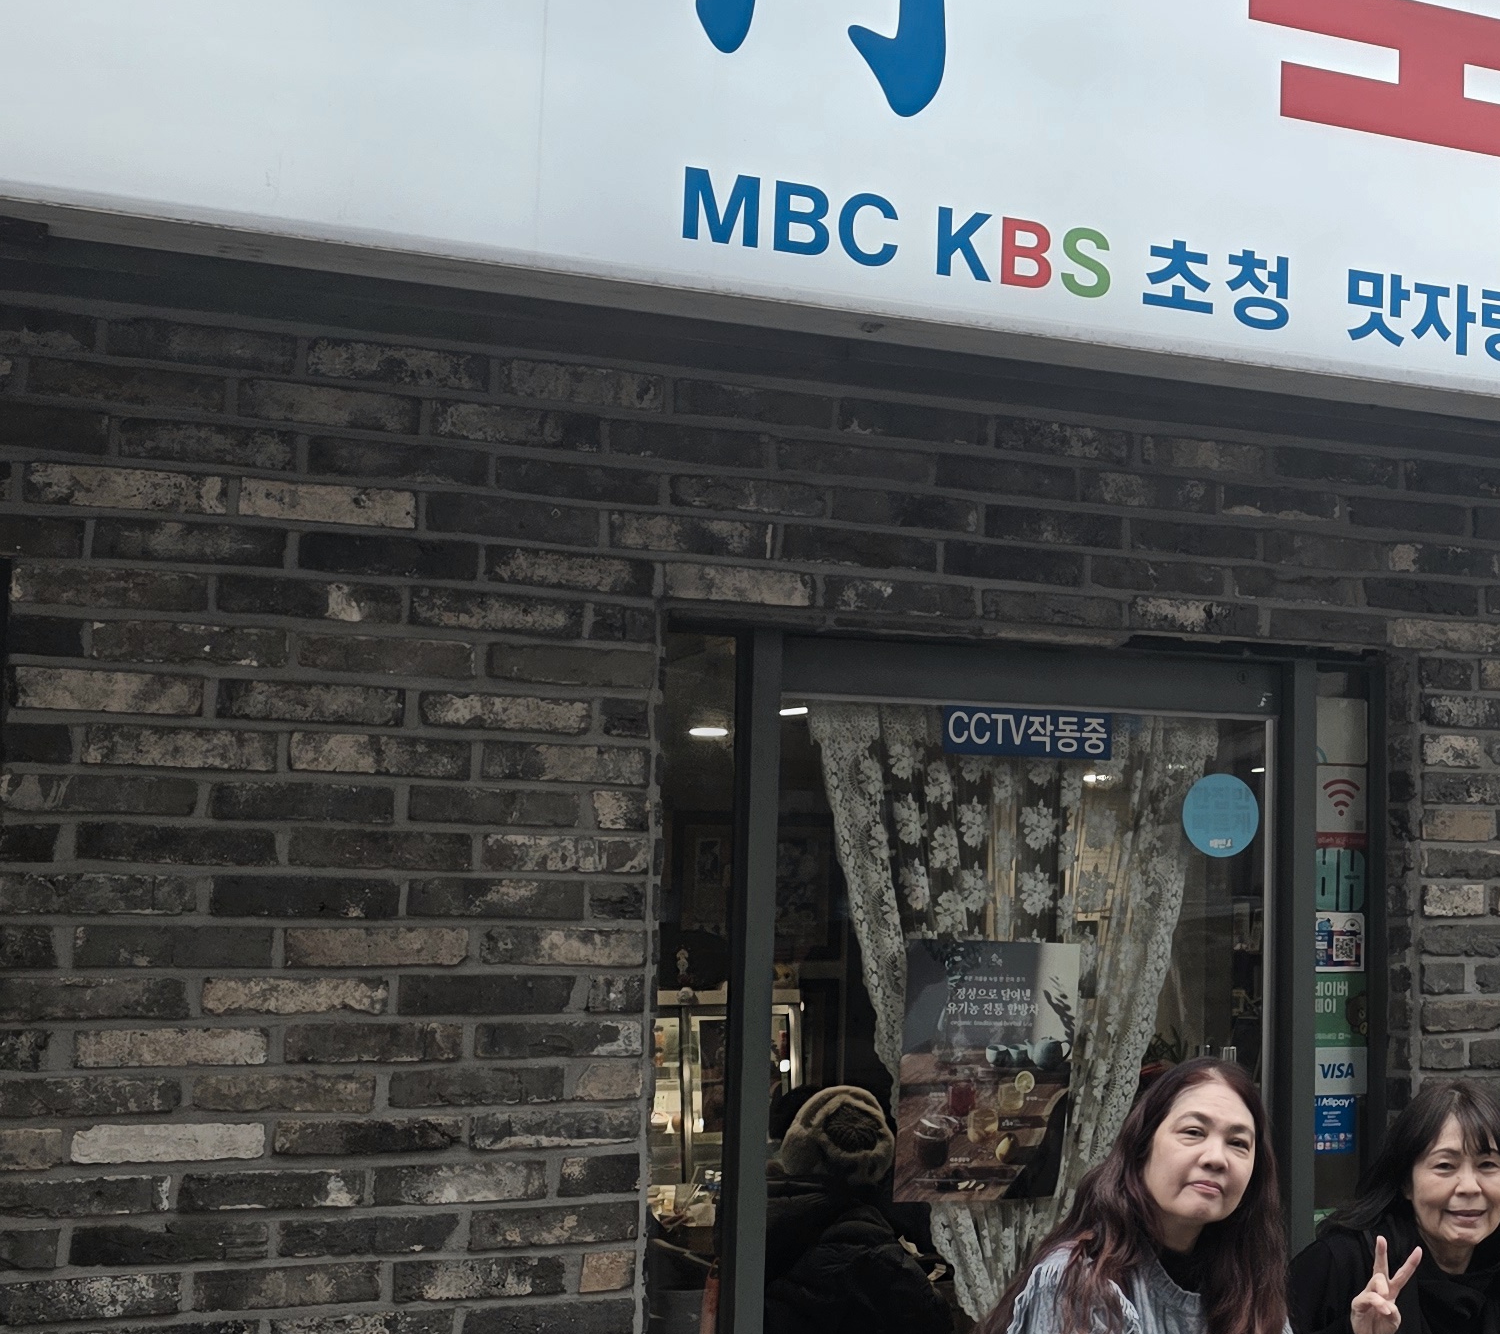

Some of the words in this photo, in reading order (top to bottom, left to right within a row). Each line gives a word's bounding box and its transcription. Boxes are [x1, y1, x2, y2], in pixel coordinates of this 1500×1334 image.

[682, 166, 899, 266] MBC
[935, 206, 1111, 298] KBS
[1142, 240, 1289, 330] 초청
[948, 711, 1107, 754] CCTV작동중
[946, 1002, 980, 1016] 유기농
[1319, 1063, 1356, 1079] VISA
